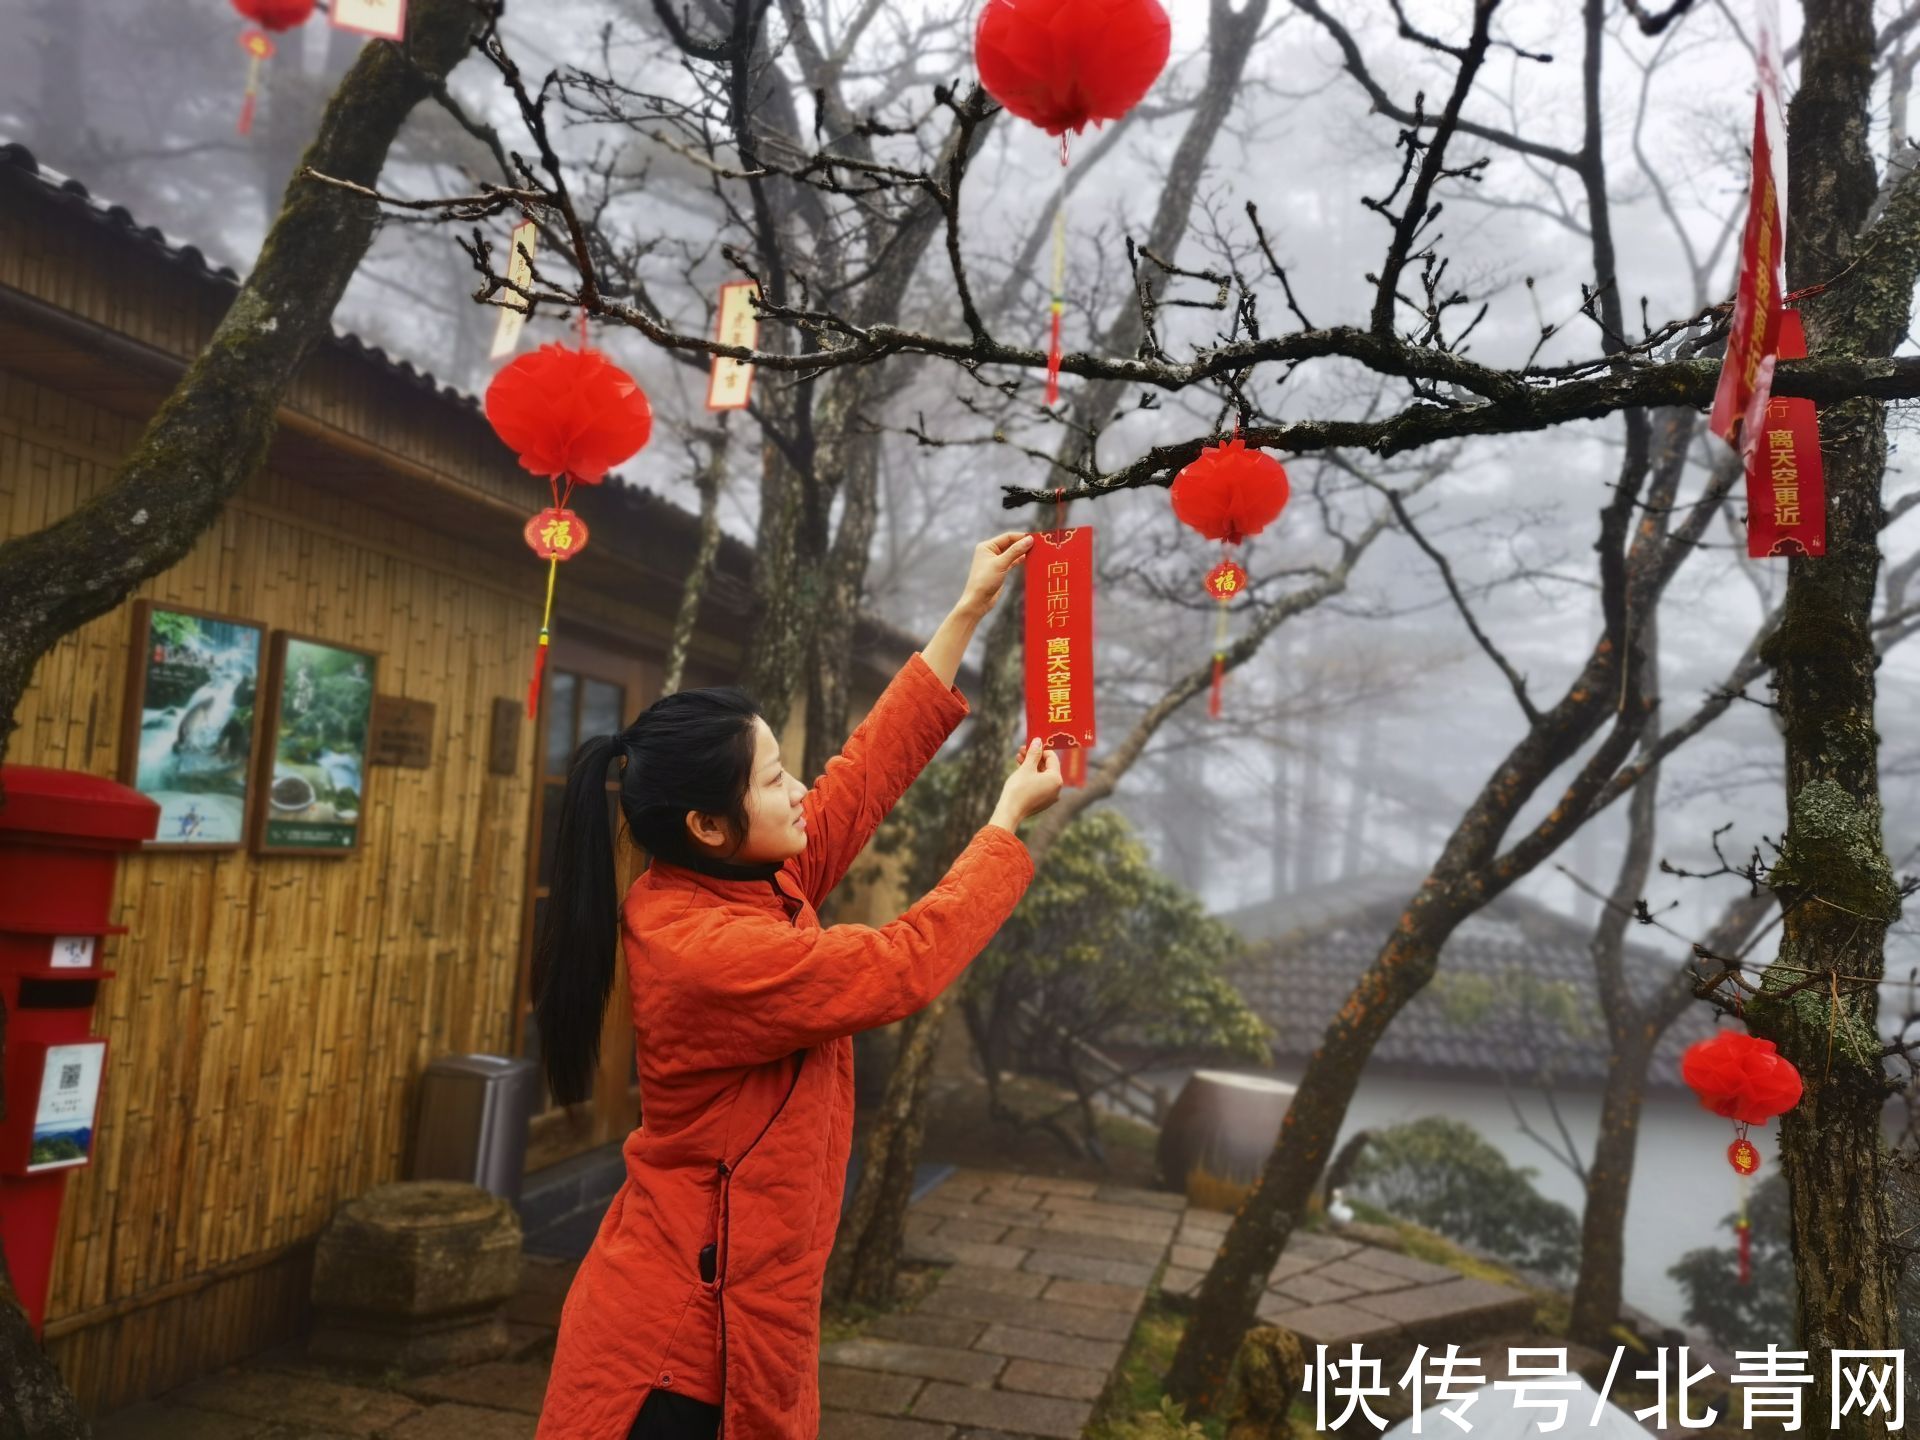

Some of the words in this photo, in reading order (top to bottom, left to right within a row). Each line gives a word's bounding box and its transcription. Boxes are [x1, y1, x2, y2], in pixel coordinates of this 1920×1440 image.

[1767, 429, 1801, 526] 离天空更近
[540, 519, 572, 550] 福
[1046, 561, 1071, 629] 向山而行
[1214, 569, 1236, 592] 福
[1046, 637, 1073, 723] 离天空更近
